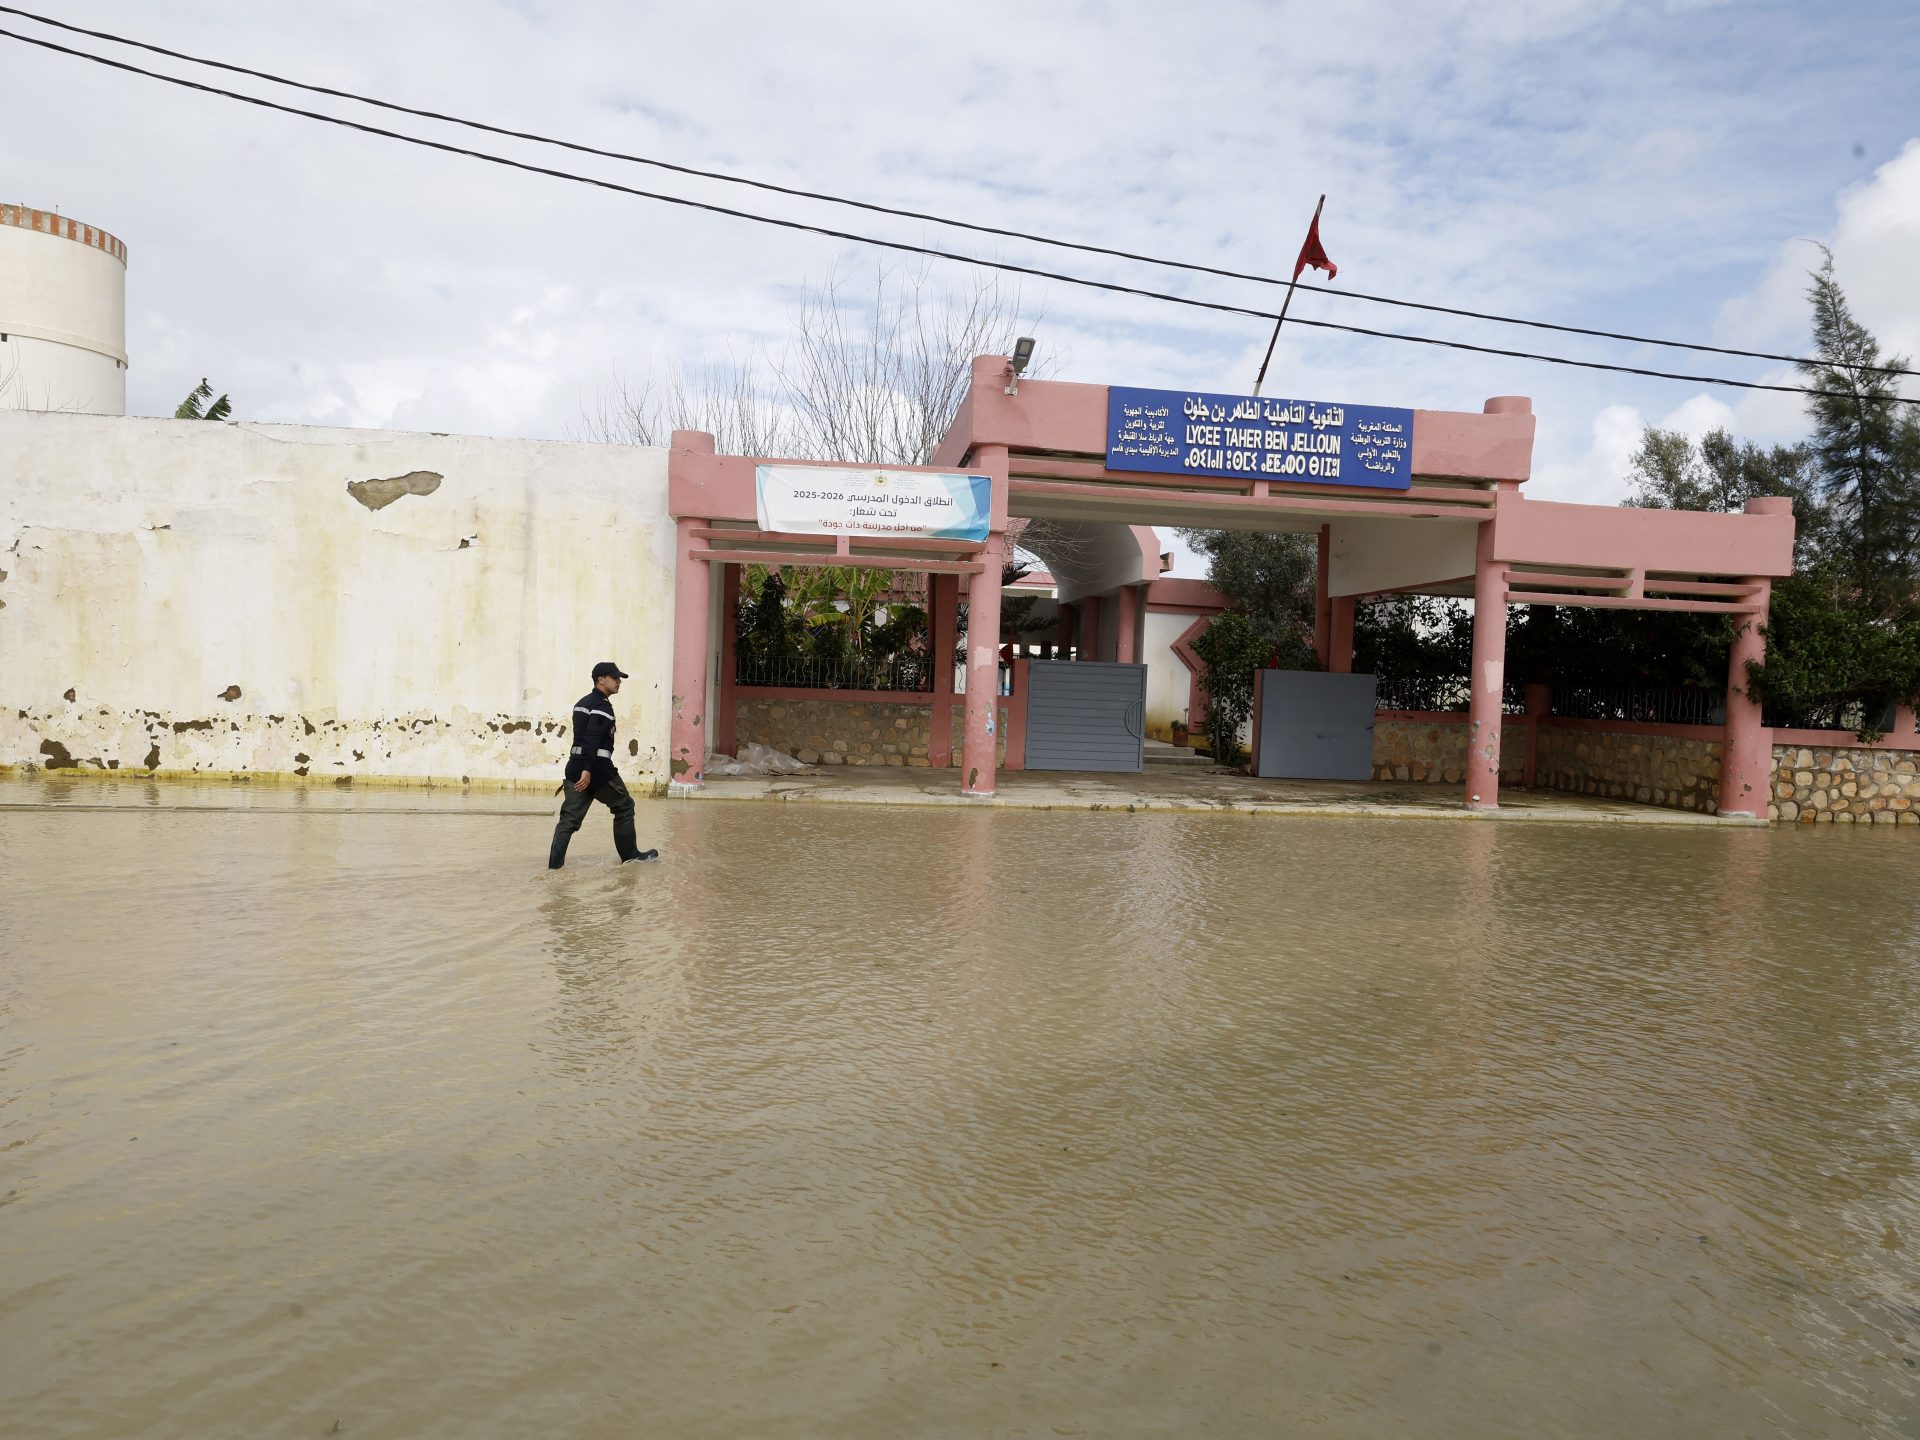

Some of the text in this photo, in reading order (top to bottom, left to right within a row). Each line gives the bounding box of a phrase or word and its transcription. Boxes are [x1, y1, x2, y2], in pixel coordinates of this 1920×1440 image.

[1124, 404, 1168, 418] الأكاديمية الجهوية
[1184, 397, 1344, 430] الثانوية التأهيلية الطاهر بن جلون
[1125, 420, 1164, 430] للتربية والتكوين
[1358, 420, 1402, 432] المملكة المغربية
[1118, 430, 1174, 444] جهة الرباط سلا القنيطرة
[1186, 425, 1341, 454] LYCEE TAHER BEN JELLOUN
[1350, 433, 1407, 448] وزارة التربية الوطنية
[1112, 443, 1123, 454] قاسم
[1125, 446, 1138, 456] سيدي
[1159, 445, 1178, 457] المديرية
[1382, 450, 1400, 461] والتعليم
[793, 491, 953, 507] انطلاق الدخول المدرسي 2025-2026
[849, 506, 897, 517] تحت شعار:
[845, 521, 860, 529] ذات
[863, 521, 892, 531] مدرسة
